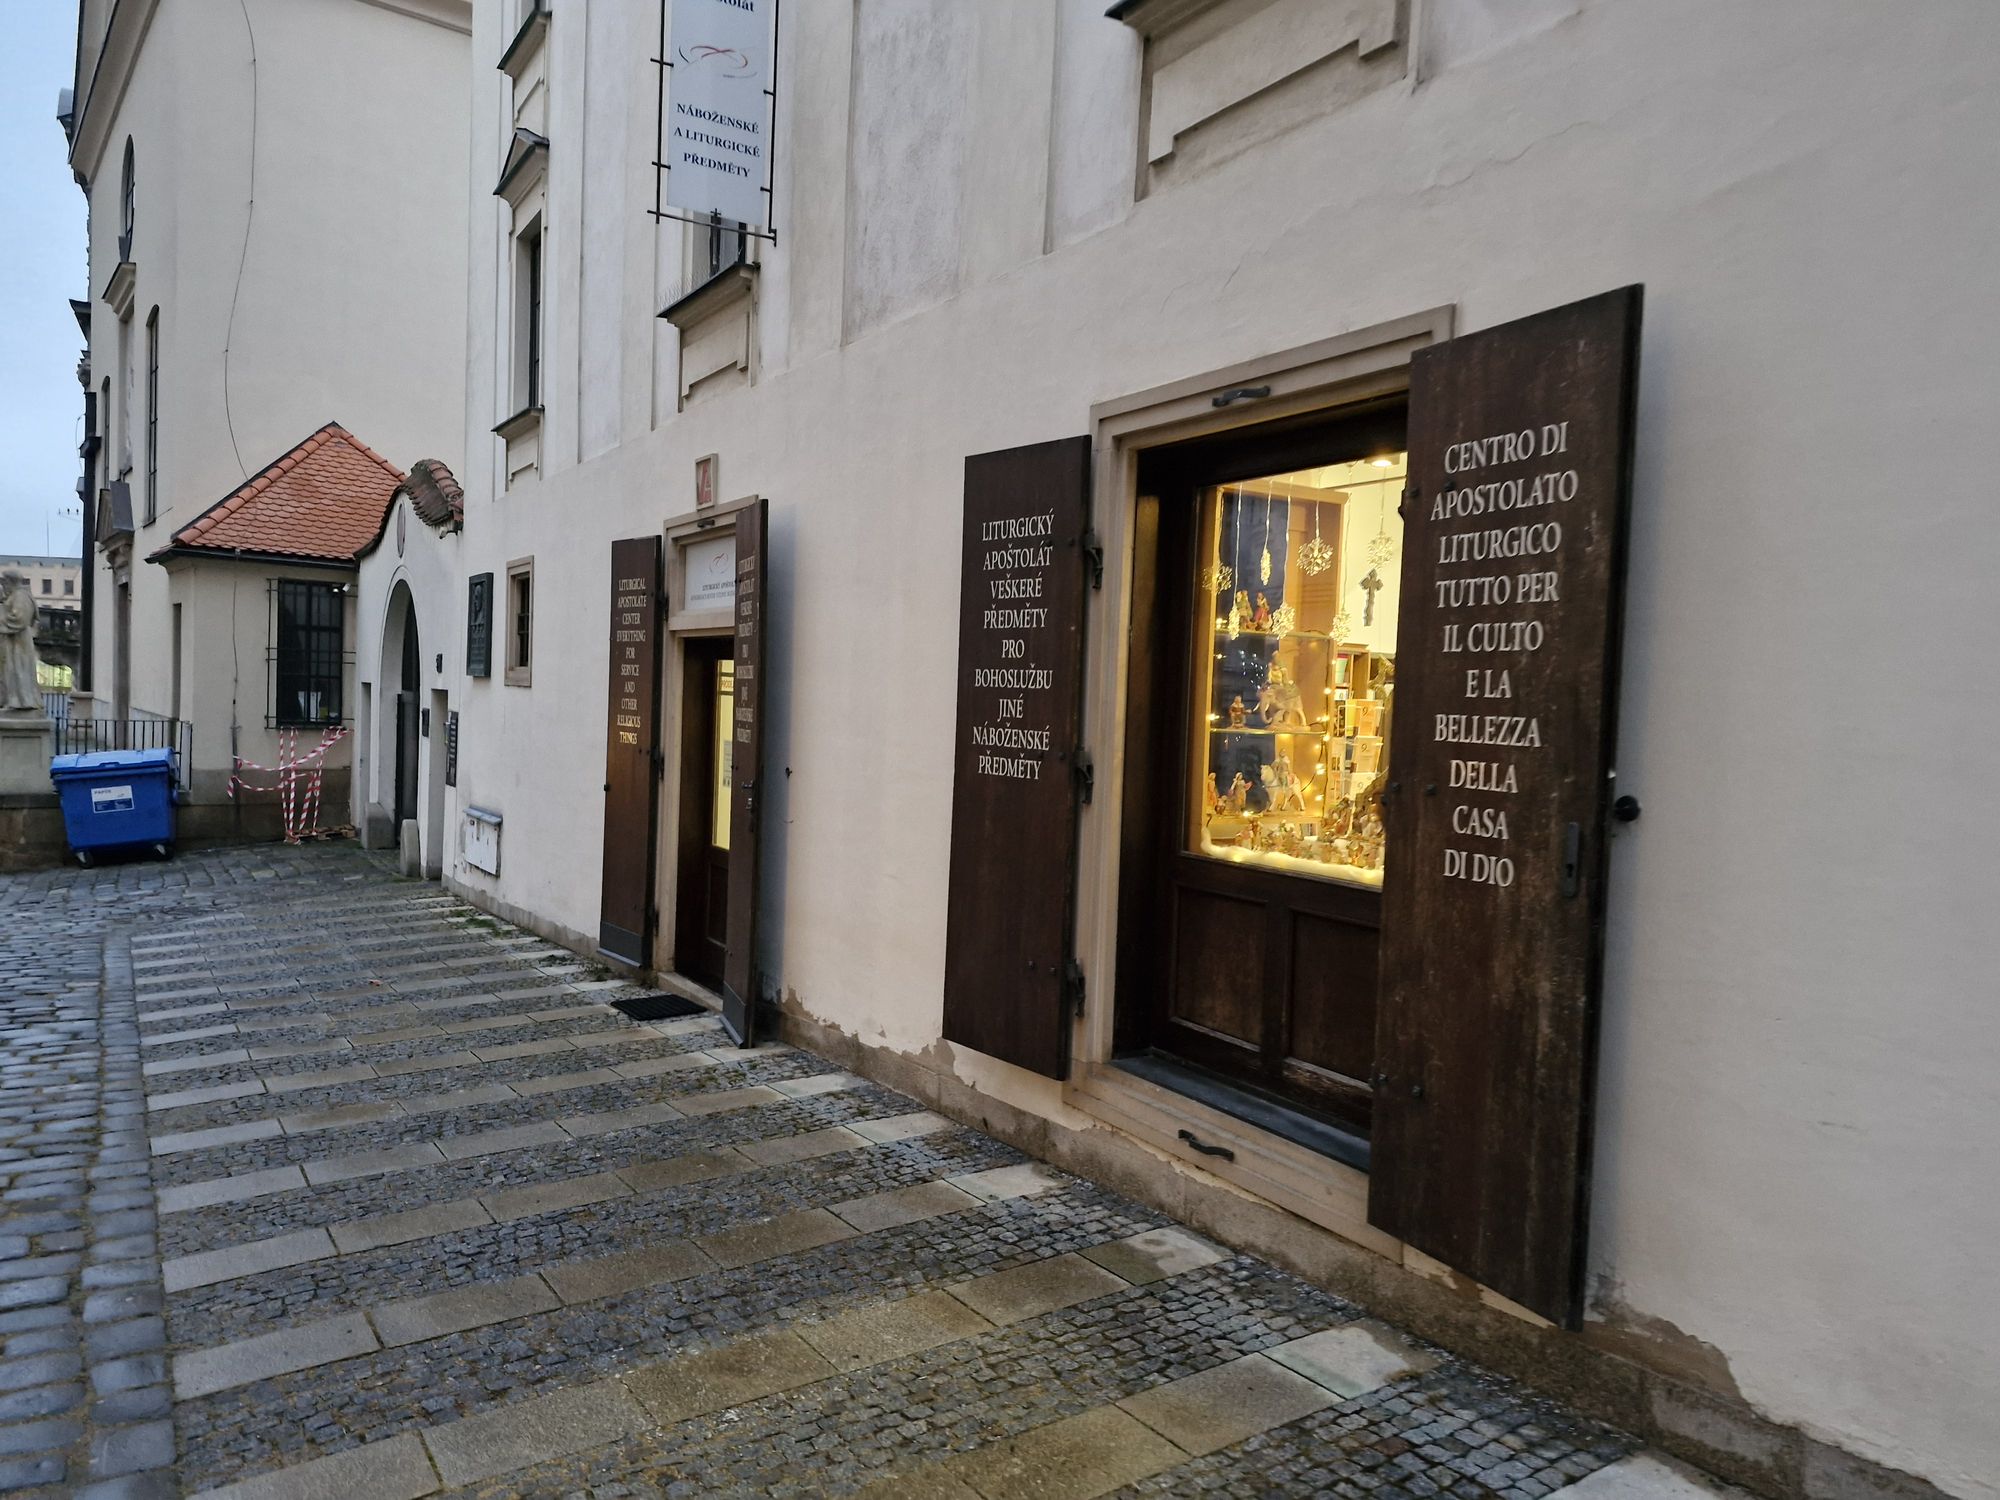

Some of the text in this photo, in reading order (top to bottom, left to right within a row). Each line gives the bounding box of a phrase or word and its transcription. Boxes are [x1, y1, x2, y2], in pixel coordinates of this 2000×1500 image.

[676, 103, 759, 134] NÁBOŽENSKÉ
[674, 126, 760, 158] A LITURGICKÉ
[683, 152, 751, 178] PŘEDMĚTY
[1444, 420, 1568, 475] CENTRO DI
[1430, 469, 1579, 521] APOSTOLATO
[982, 508, 1055, 541] LITURGICKÝ
[983, 540, 1053, 571] APOŠTOLÁT
[1438, 521, 1562, 565] LITURGICO
[618, 578, 646, 591] LITURGICAL
[990, 572, 1043, 599] VEŠKERÉ
[1435, 571, 1560, 610] TUTTO PER
[617, 595, 647, 608] APOSTOLATE
[984, 602, 1048, 630] PŘEDMĚTY
[622, 613, 641, 625] CENTER
[616, 630, 646, 642] EVERYTHING
[1001, 639, 1025, 659] PRO
[1442, 620, 1544, 654] IL CULTO
[625, 647, 635, 659] FOR
[620, 664, 640, 676] SERVICE
[974, 663, 1053, 690] BOHOSLUŽBU
[1465, 670, 1511, 699] E LA
[624, 681, 635, 693] AND
[621, 698, 638, 710] OTHER
[997, 694, 1024, 723] JINÉ
[616, 714, 641, 728] RELIGIOUS
[1433, 713, 1543, 748] BELLEZZA
[619, 731, 638, 745] THINGS
[972, 721, 1050, 752] NÁBOŽENSKÉ
[978, 750, 1042, 780] PŘEDMĚTY
[1449, 759, 1519, 794] DELLA
[1452, 804, 1510, 841] CASA
[1443, 849, 1515, 888] DI DIO
